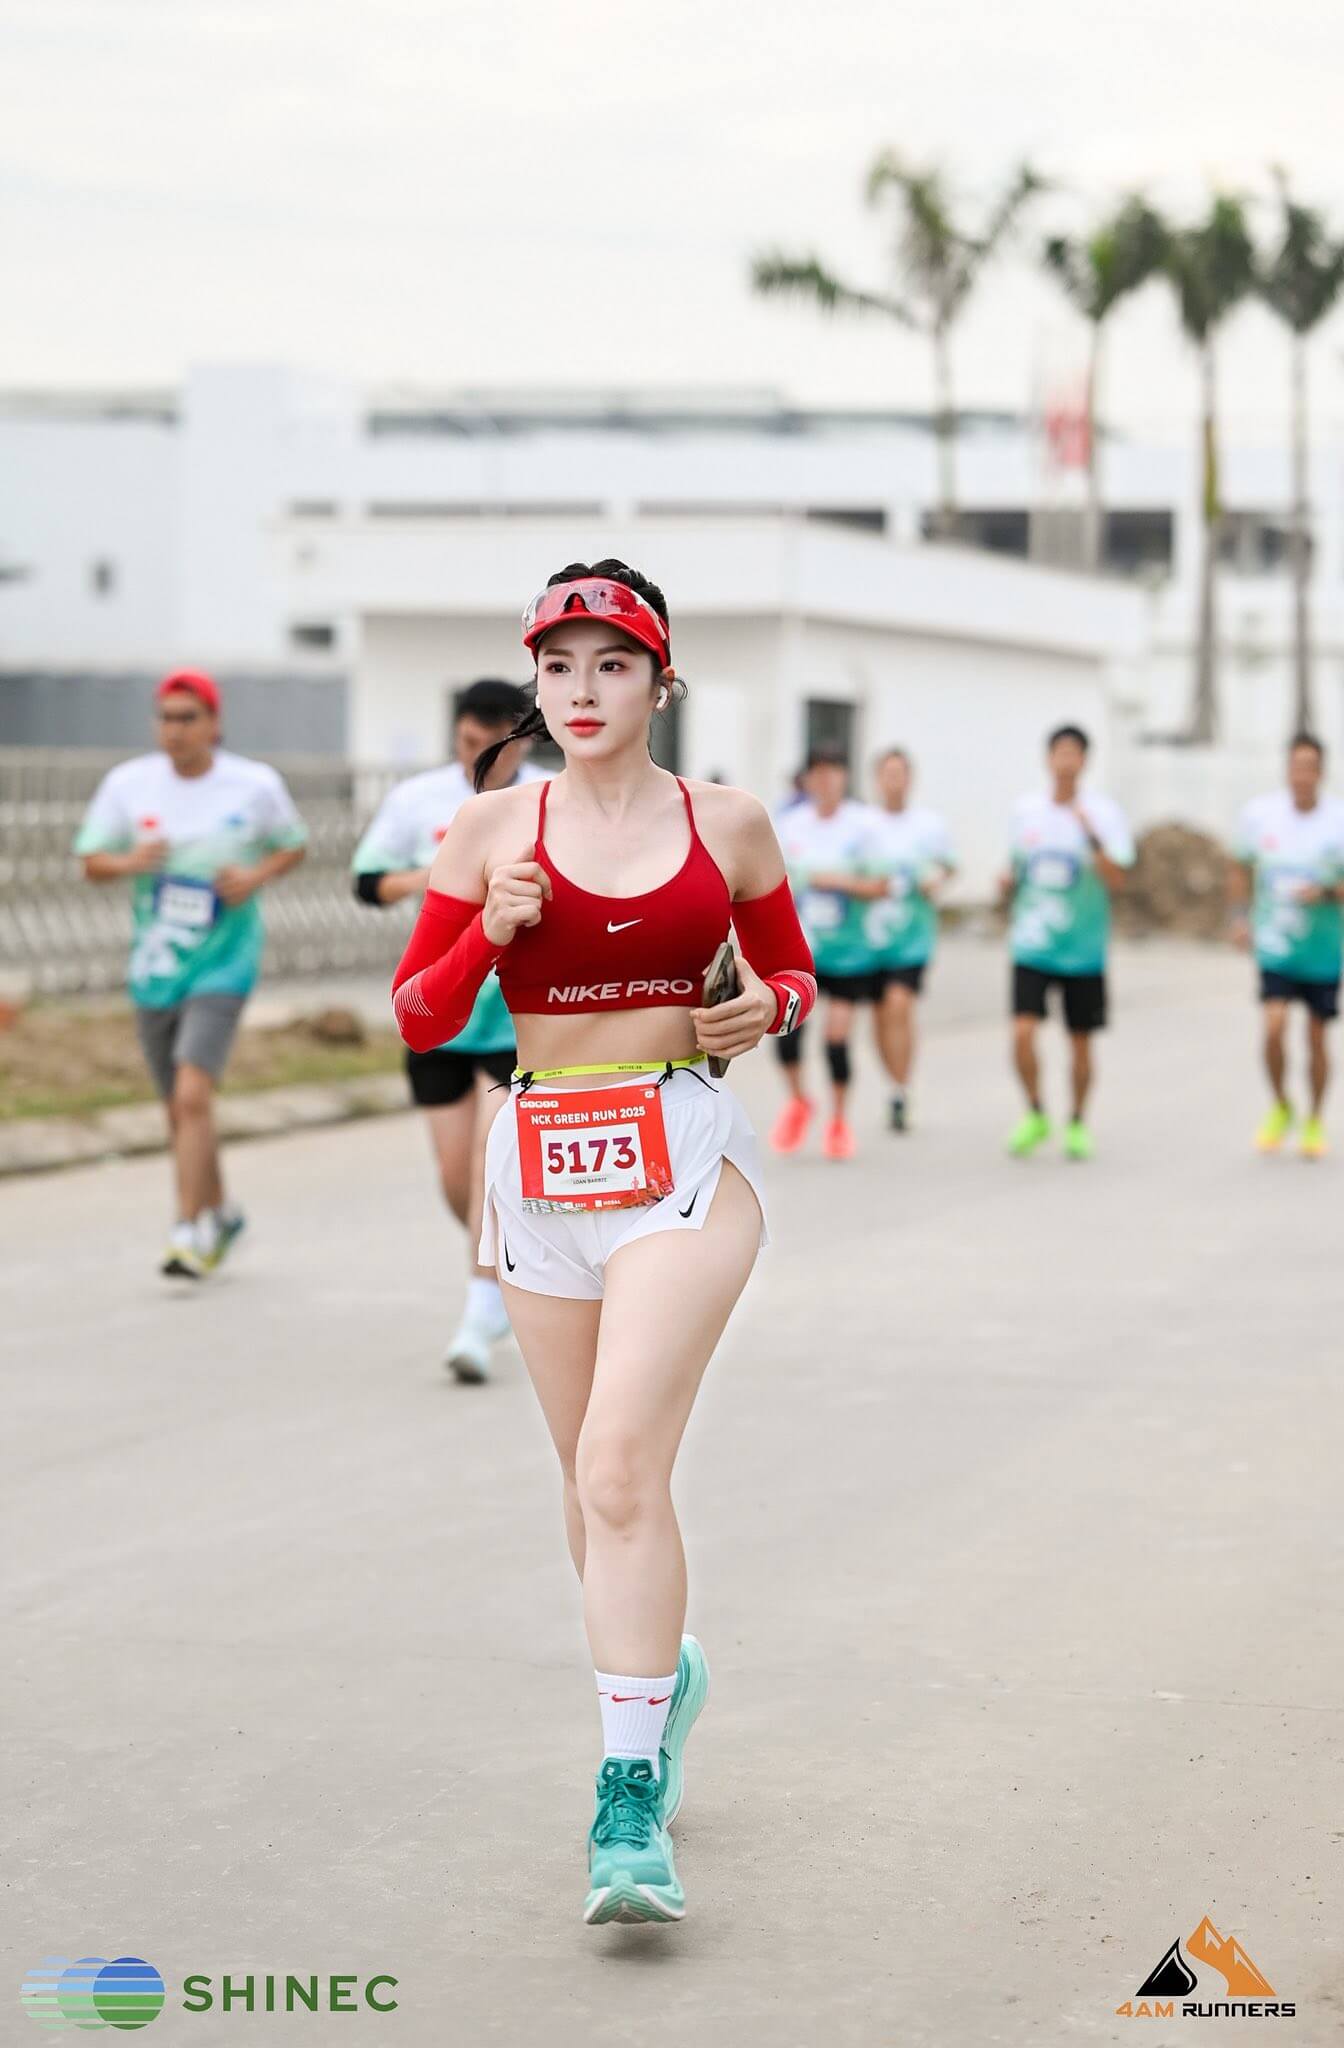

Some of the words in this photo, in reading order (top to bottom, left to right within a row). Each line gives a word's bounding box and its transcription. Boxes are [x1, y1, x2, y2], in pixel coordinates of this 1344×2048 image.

[547, 983, 622, 1003] NIKE
[626, 979, 693, 997] PRO
[531, 1114, 551, 1125] NCK
[554, 1112, 589, 1124] GREEN
[593, 1109, 617, 1121] RUN
[620, 1106, 645, 1119] 2025
[548, 1136, 637, 1174] 5173
